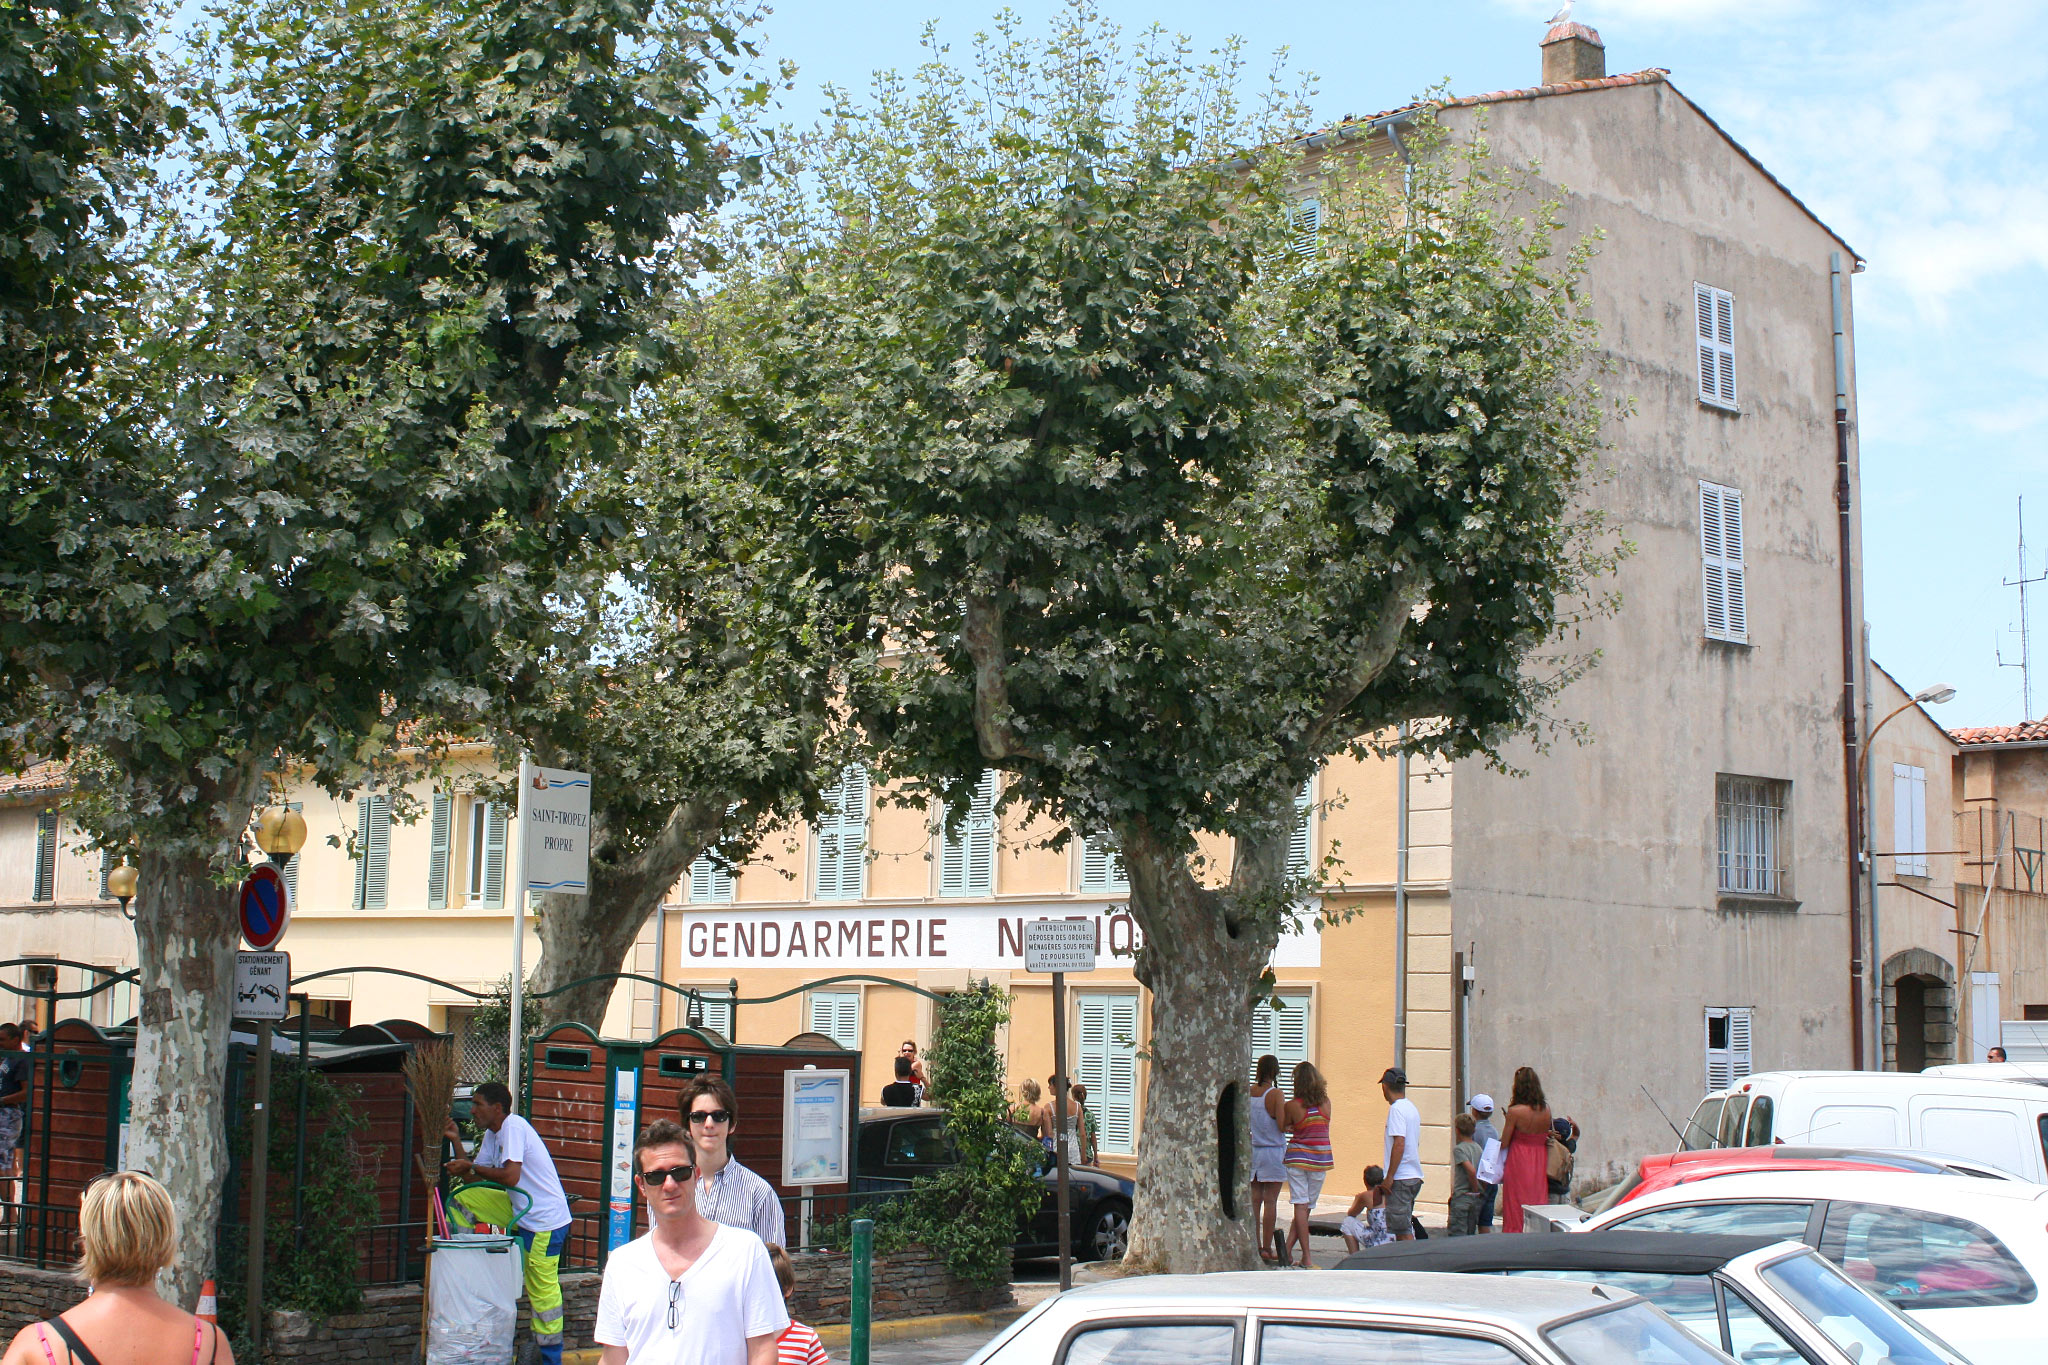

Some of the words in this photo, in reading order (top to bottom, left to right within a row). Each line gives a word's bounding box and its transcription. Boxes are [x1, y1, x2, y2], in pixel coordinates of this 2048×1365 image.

[532, 808, 586, 827] SAINT-TROPEZ
[544, 837, 573, 852] PROPRE
[1035, 924, 1077, 932] INTERDICTION
[1078, 924, 1086, 932] DE
[689, 919, 947, 958] GENDARMERIE
[1028, 933, 1054, 941] DÉPOSER
[238, 955, 283, 964] STATIONNEMENT
